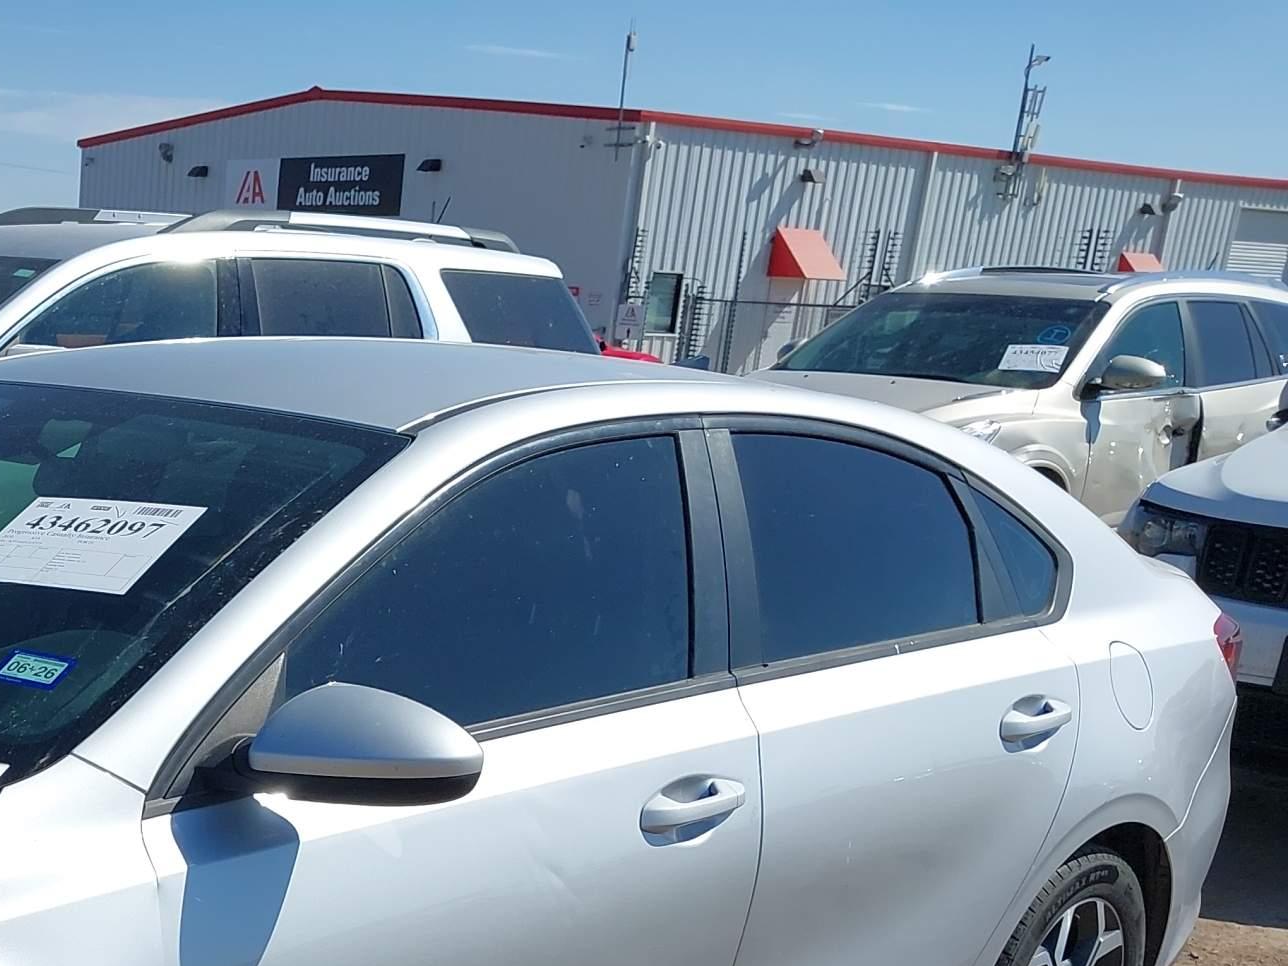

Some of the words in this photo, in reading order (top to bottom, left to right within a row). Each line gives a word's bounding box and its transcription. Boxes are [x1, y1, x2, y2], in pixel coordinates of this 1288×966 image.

[310, 162, 370, 182] Insurance
[296, 187, 323, 206] Auto
[326, 186, 380, 206] Auctions
[25, 514, 167, 539] 43462097
